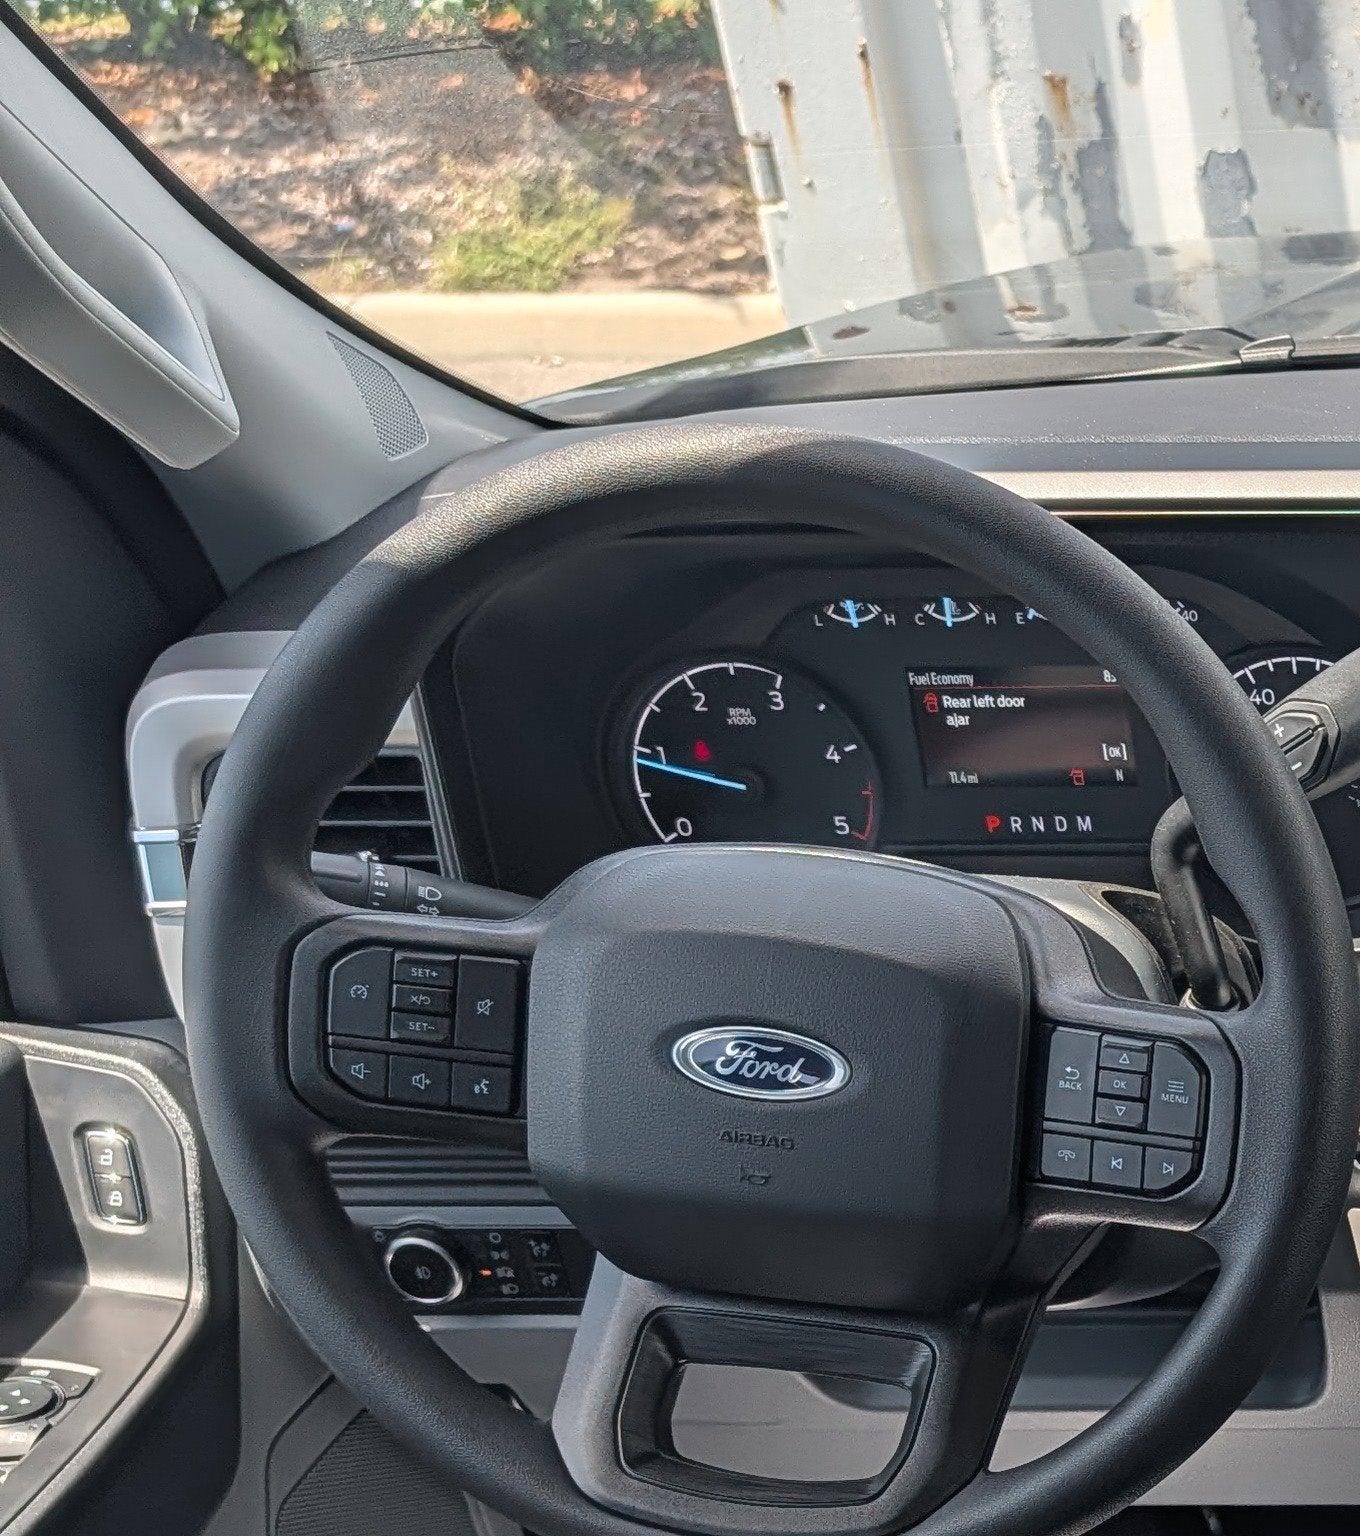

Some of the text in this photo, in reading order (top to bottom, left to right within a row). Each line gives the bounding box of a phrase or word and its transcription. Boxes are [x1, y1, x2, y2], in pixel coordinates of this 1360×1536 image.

[814, 615, 823, 626] L
[885, 614, 896, 626] H
[915, 614, 925, 625] C
[986, 614, 996, 624] H
[1016, 614, 1025, 624] E
[908, 672, 974, 687] Fuel Economy
[692, 692, 708, 711] 2
[768, 691, 784, 710] 3
[942, 695, 1025, 708] Rear left door
[1250, 689, 1275, 705] 40
[729, 708, 750, 716] RPM
[946, 714, 970, 728] ajar
[655, 746, 666, 765] 1
[826, 745, 842, 764] 4
[1116, 769, 1124, 782] N
[676, 817, 692, 836] 0
[834, 816, 850, 834] 5
[984, 815, 1092, 834] P R N D M
[715, 1040, 820, 1084] Ford
[1058, 1080, 1082, 1091] BACK
[1113, 1080, 1127, 1090] OK
[1161, 1093, 1188, 1104] MENU
[719, 1130, 796, 1150] AIRBAG
